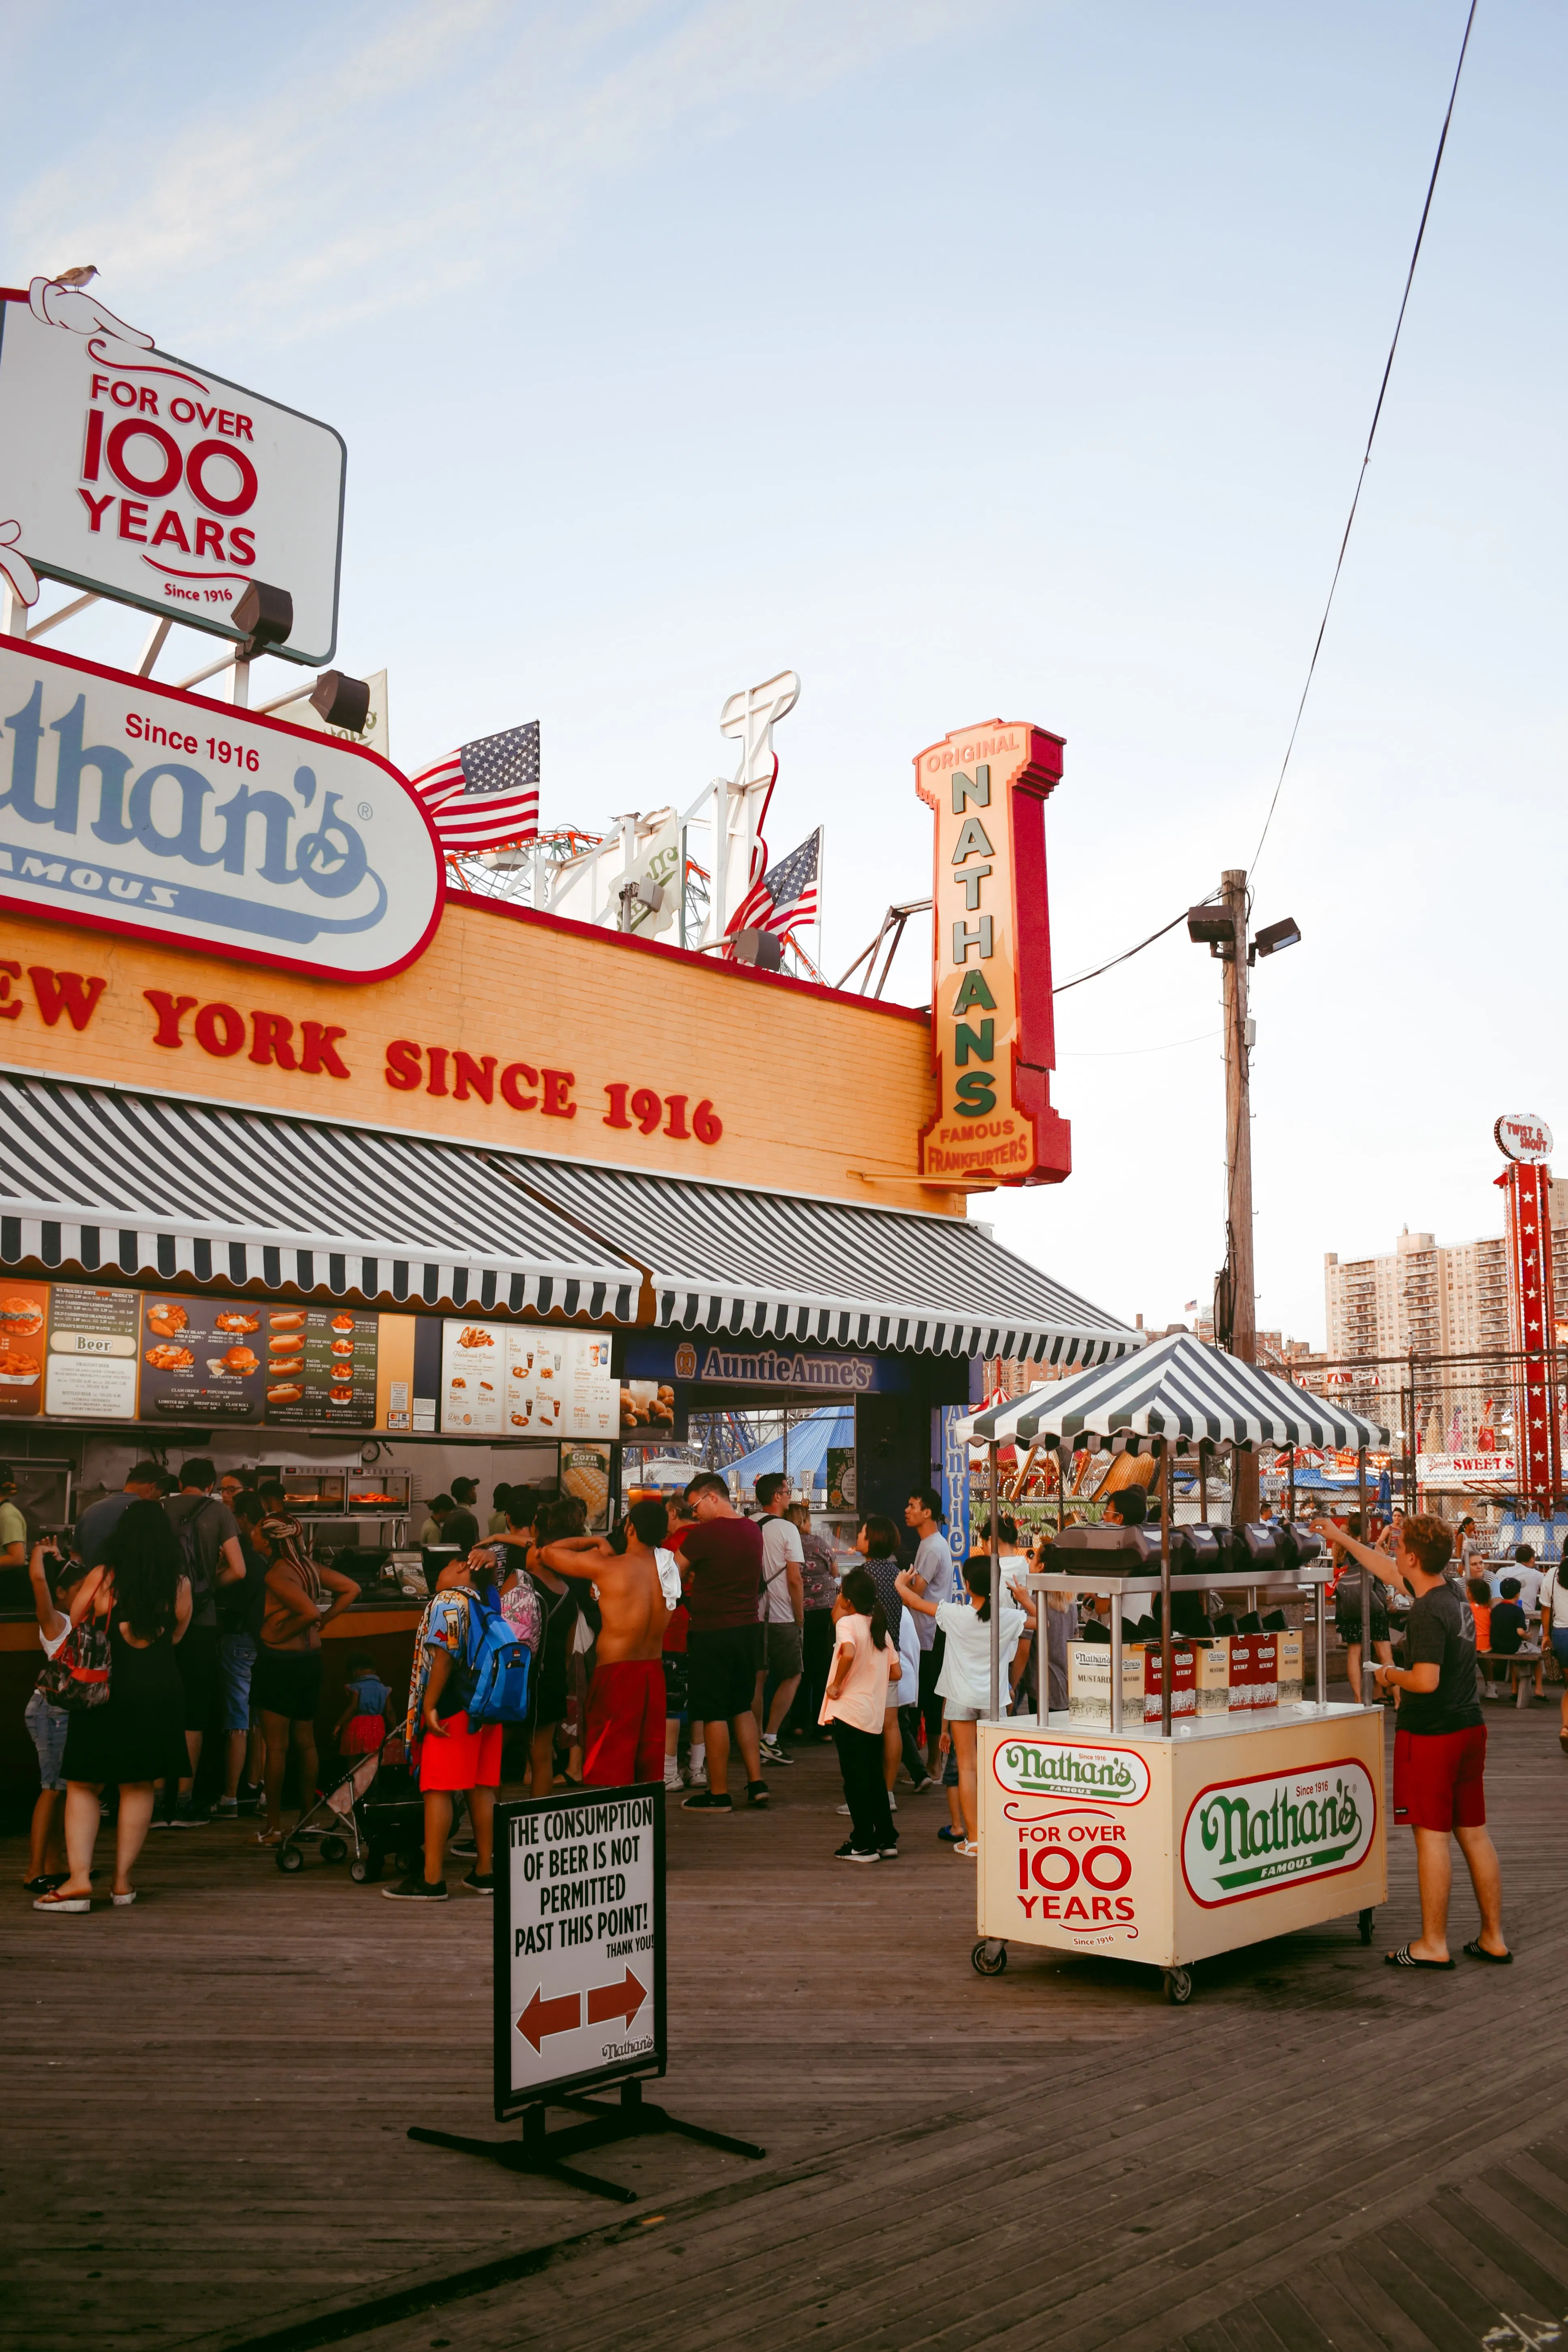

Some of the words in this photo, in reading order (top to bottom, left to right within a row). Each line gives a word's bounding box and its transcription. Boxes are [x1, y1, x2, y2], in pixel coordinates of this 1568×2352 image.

[91, 374, 158, 415] FOR
[170, 398, 254, 442] OVER
[81, 408, 258, 517] 100
[77, 488, 256, 566] YEARS
[164, 583, 201, 602] Since
[203, 588, 233, 602] 1916
[125, 713, 198, 755] Since
[206, 738, 260, 772] 1916
[926, 732, 1019, 772] ORIGINAL
[0, 680, 368, 899] than's
[951, 764, 997, 1117] NATHANS
[143, 990, 351, 1079] YORK
[385, 1039, 577, 1119] SINCE
[603, 1083, 723, 1145] 1916
[939, 1119, 1014, 1144] FAMOUS
[1506, 1122, 1533, 1139] TWIST
[1536, 1128, 1543, 1140] &
[1520, 1136, 1547, 1152] SHOUT
[928, 1133, 1027, 1173] FRANKFURTERS
[77, 1336, 111, 1351] Beer
[572, 1453, 597, 1461] Corn
[1453, 1458, 1502, 1471] SWEET
[1176, 1654, 1192, 1662] Nathan's
[1078, 1674, 1110, 1683] MUSTARD
[1006, 1744, 1132, 1787] Nathan's
[1050, 1785, 1092, 1794] FAMOUS
[1296, 1785, 1313, 1797] Since
[1315, 1781, 1329, 1793] 1916
[510, 1816, 539, 1848] THE
[544, 1798, 652, 1842] CONSUMPTION
[1018, 1827, 1061, 1842] FOR
[1068, 1825, 1126, 1842] OVER
[1200, 1778, 1356, 1865] Nathan's
[524, 1851, 544, 1882] OF
[549, 1844, 588, 1878] BEER
[593, 1841, 607, 1870] IS
[611, 1835, 640, 1867] NOT
[1019, 1845, 1132, 1891] 100
[1260, 1856, 1313, 1877] FAMOUS
[540, 1873, 626, 1916] PERMITTED
[1017, 1896, 1135, 1921] YEARS
[515, 1922, 554, 1957] PAST
[558, 1914, 593, 1948] THIS
[598, 1903, 648, 1940] POINT!
[1074, 1937, 1095, 1945] Since
[1096, 1935, 1114, 1944] 1916
[606, 1939, 633, 1959] THANK
[635, 1934, 654, 1951] YOU!
[601, 2034, 653, 2060] Nathan's
